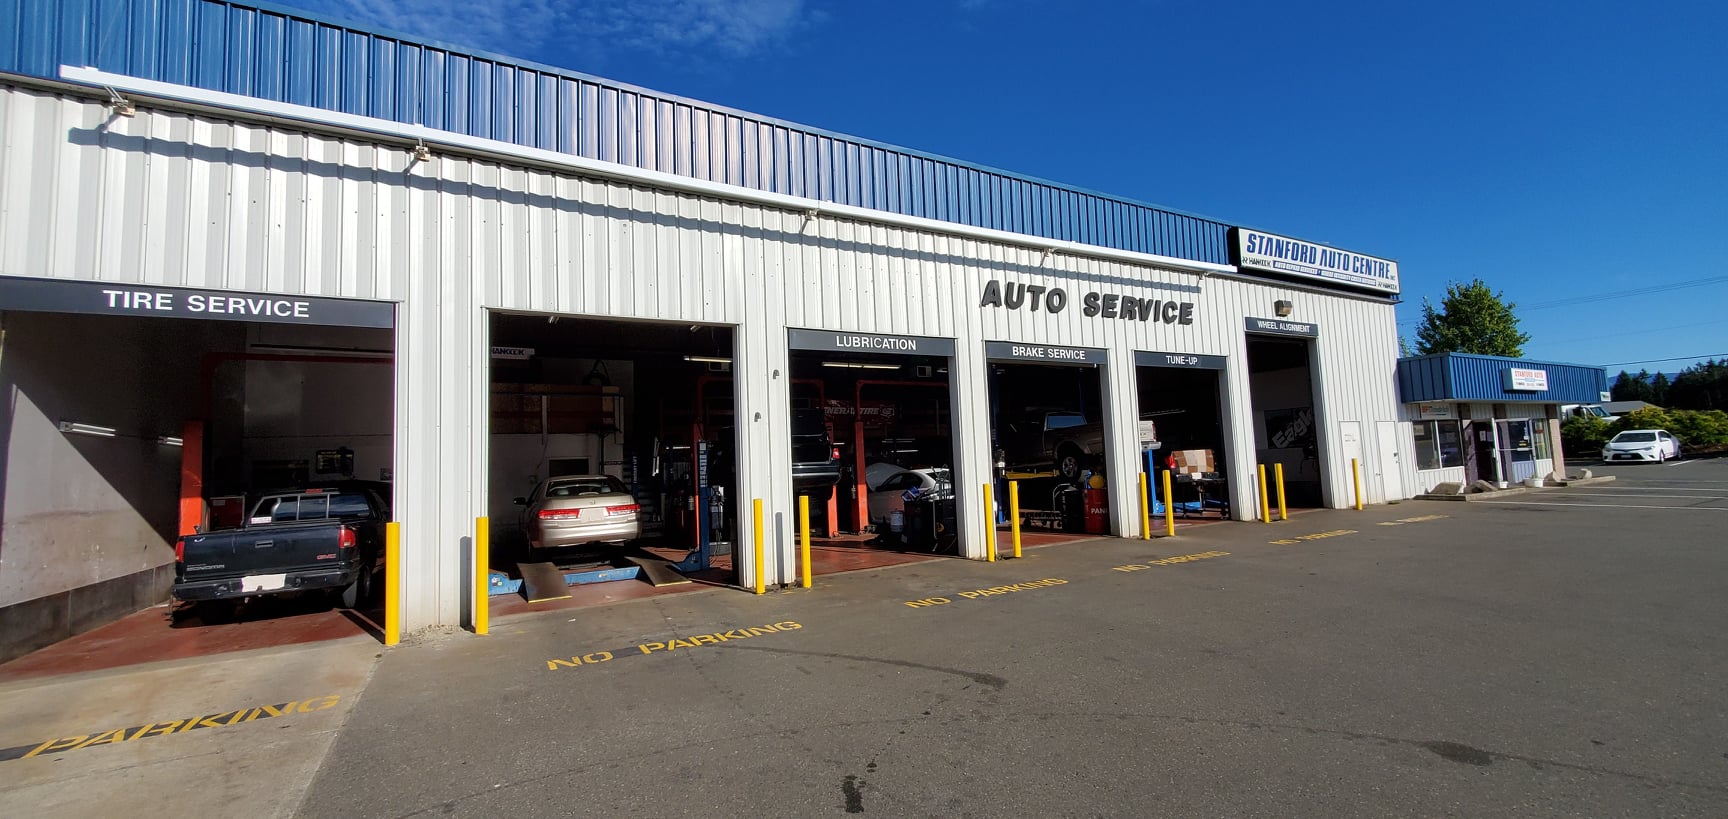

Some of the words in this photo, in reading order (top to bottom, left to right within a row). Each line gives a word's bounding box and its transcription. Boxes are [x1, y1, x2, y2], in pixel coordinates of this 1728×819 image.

[1247, 233, 1317, 265] STANFORD
[1320, 248, 1350, 271] AUTO
[1352, 255, 1390, 279] CENTRE
[102, 290, 173, 310] TIRE
[187, 295, 310, 317] SERVICE
[981, 280, 1067, 314] AUTO
[1083, 292, 1194, 325] SERVICE
[1257, 320, 1278, 329] WHEEL
[1279, 323, 1310, 333] ALIGNMENT
[836, 335, 916, 350] LUBRICATION
[1012, 346, 1044, 358] BRAKE
[1047, 348, 1086, 360] SERVICE
[1165, 355, 1198, 365] TUNE-UP
[860, 407, 880, 415] TIRE
[1148, 550, 1231, 566] PARKING
[904, 597, 951, 609] NO
[958, 578, 1069, 599] PARKING
[546, 651, 613, 671] NO
[638, 621, 803, 655] PARKING
[21, 694, 341, 759] PARKING
